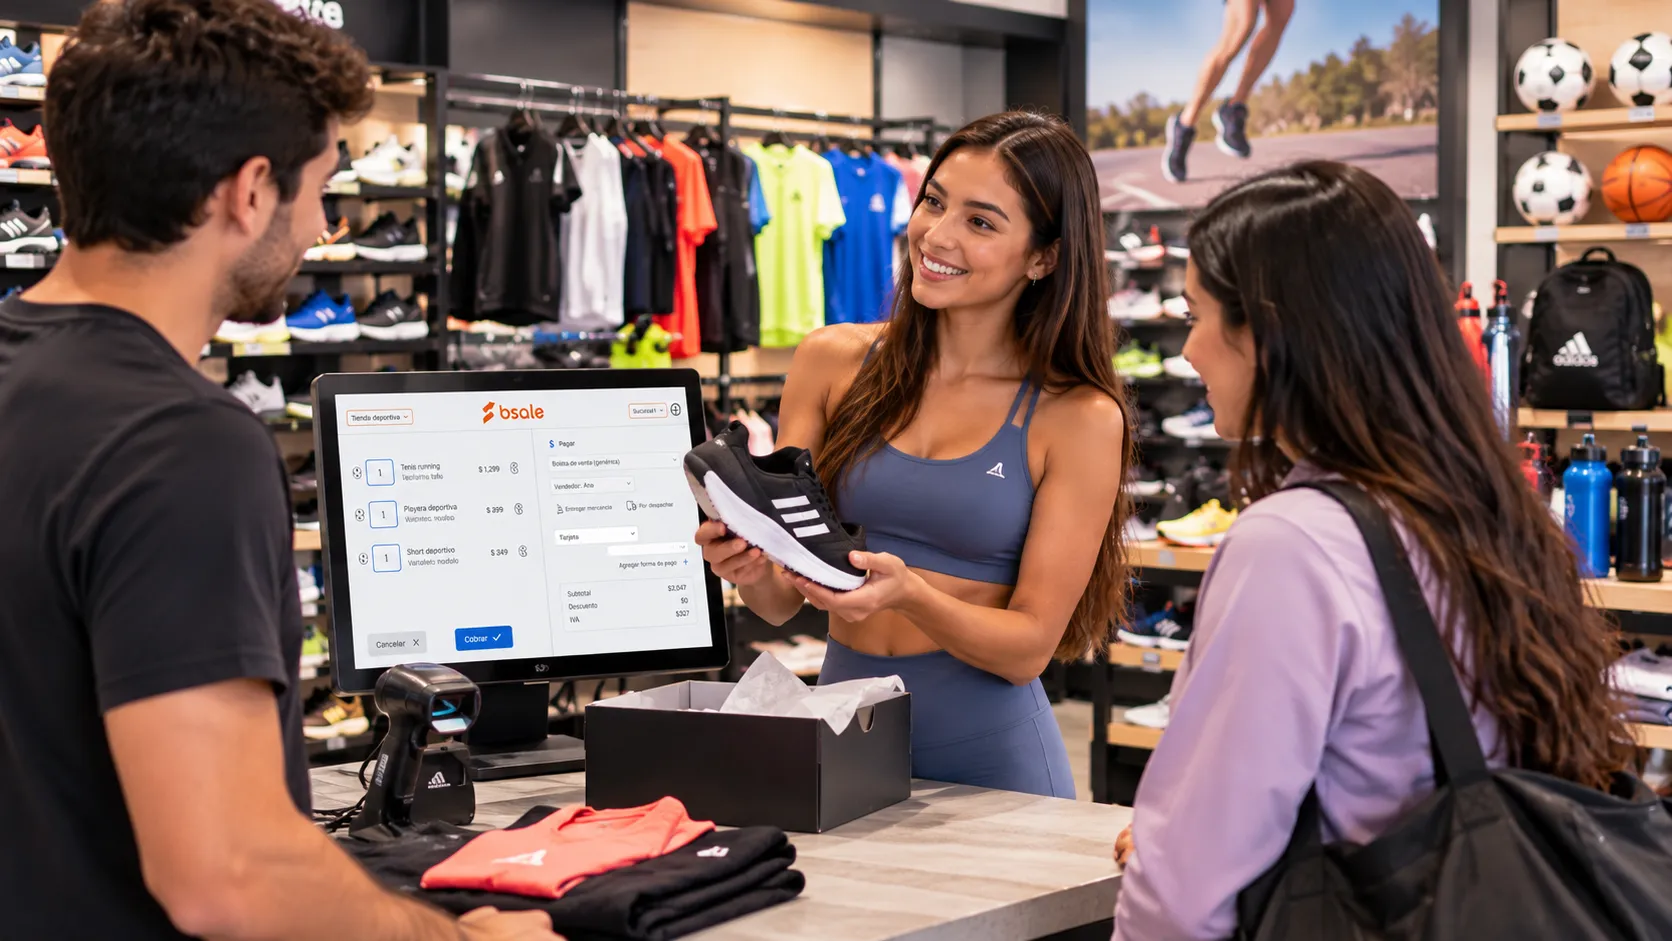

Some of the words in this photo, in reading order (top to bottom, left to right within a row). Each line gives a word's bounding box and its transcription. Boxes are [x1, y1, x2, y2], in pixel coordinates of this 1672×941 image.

[499, 403, 545, 420] bsale
[351, 414, 371, 422] Tienda
[401, 463, 417, 471] Tenis
[417, 462, 441, 472] running
[378, 468, 382, 477] 1
[428, 502, 458, 513] deportiva
[381, 510, 386, 519] 1
[406, 547, 424, 556] Short
[496, 548, 509, 557] 349
[384, 553, 389, 563] 1
[569, 615, 581, 623] IVA
[464, 634, 488, 644] Cobrar
[375, 639, 406, 649] Cancelar
